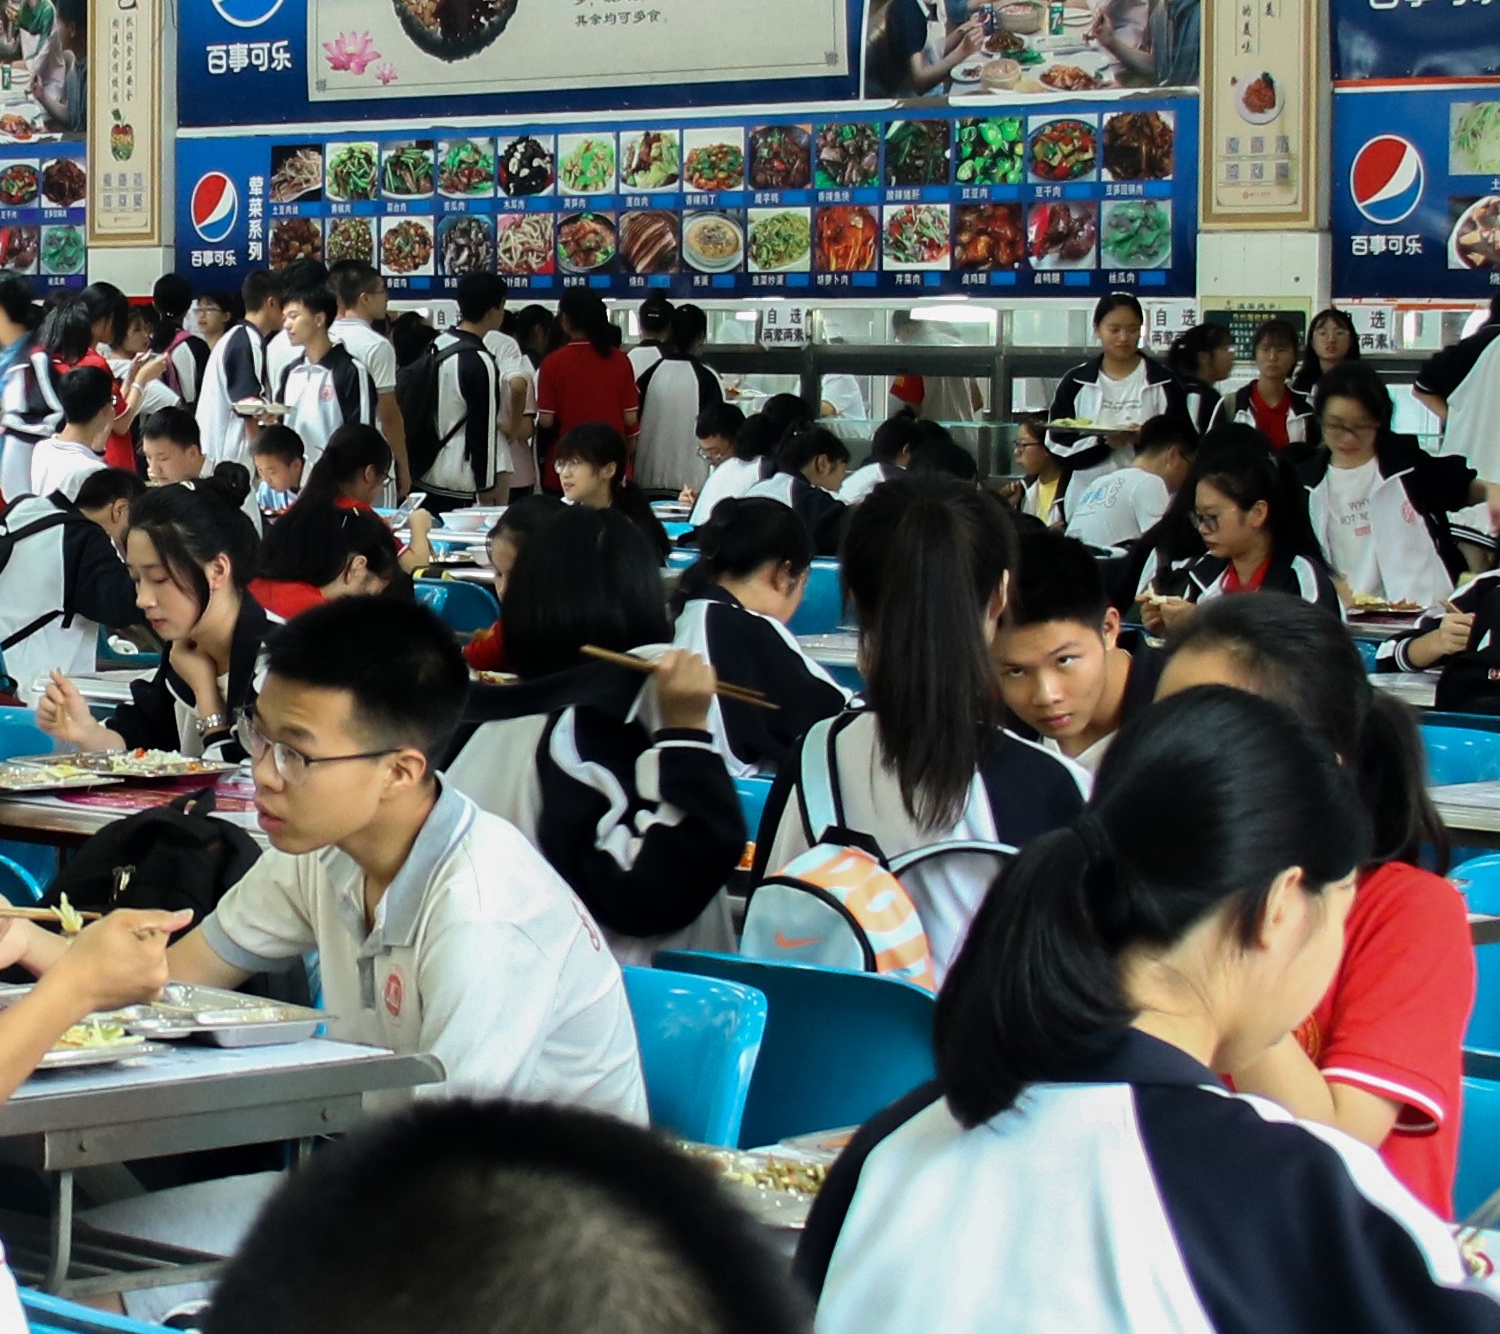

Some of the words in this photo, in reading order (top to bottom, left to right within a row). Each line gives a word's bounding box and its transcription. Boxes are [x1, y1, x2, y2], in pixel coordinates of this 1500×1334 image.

[206, 39, 292, 74] 百事可乐
[247, 175, 263, 261] 荤菜系列
[1350, 234, 1423, 256] 百事可乐
[190, 249, 237, 267] 百事可乐
[768, 308, 803, 325] 自选
[1155, 308, 1196, 327] 自选
